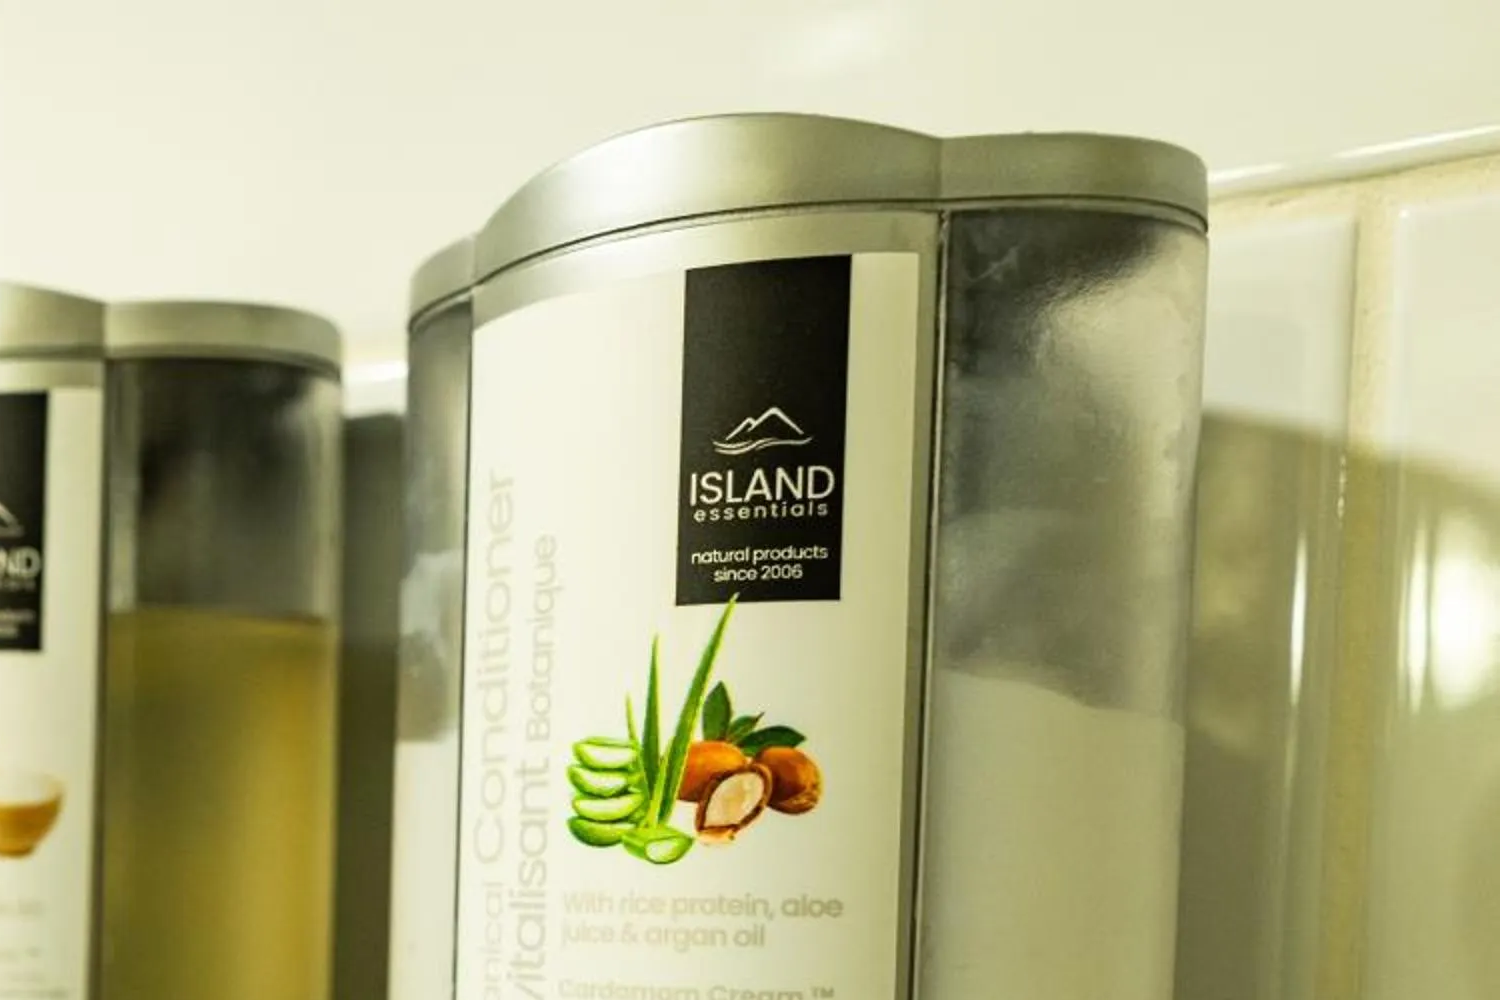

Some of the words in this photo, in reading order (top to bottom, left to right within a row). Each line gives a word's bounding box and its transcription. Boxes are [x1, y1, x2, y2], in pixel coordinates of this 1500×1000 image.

[689, 465, 836, 507] ISLAND
[693, 501, 829, 523] essentials
[691, 547, 749, 565] natural
[752, 545, 829, 565] products
[713, 566, 758, 583] since
[760, 564, 803, 580] 2006
[524, 533, 564, 743] Botanique
[473, 467, 515, 865] Conditioner
[563, 892, 614, 915] With
[619, 891, 666, 915] rice
[671, 893, 775, 921] protein,
[780, 895, 845, 918] aloe
[561, 921, 615, 950] juice
[620, 922, 639, 945] &
[644, 926, 728, 953] argan
[733, 924, 765, 948] oil
